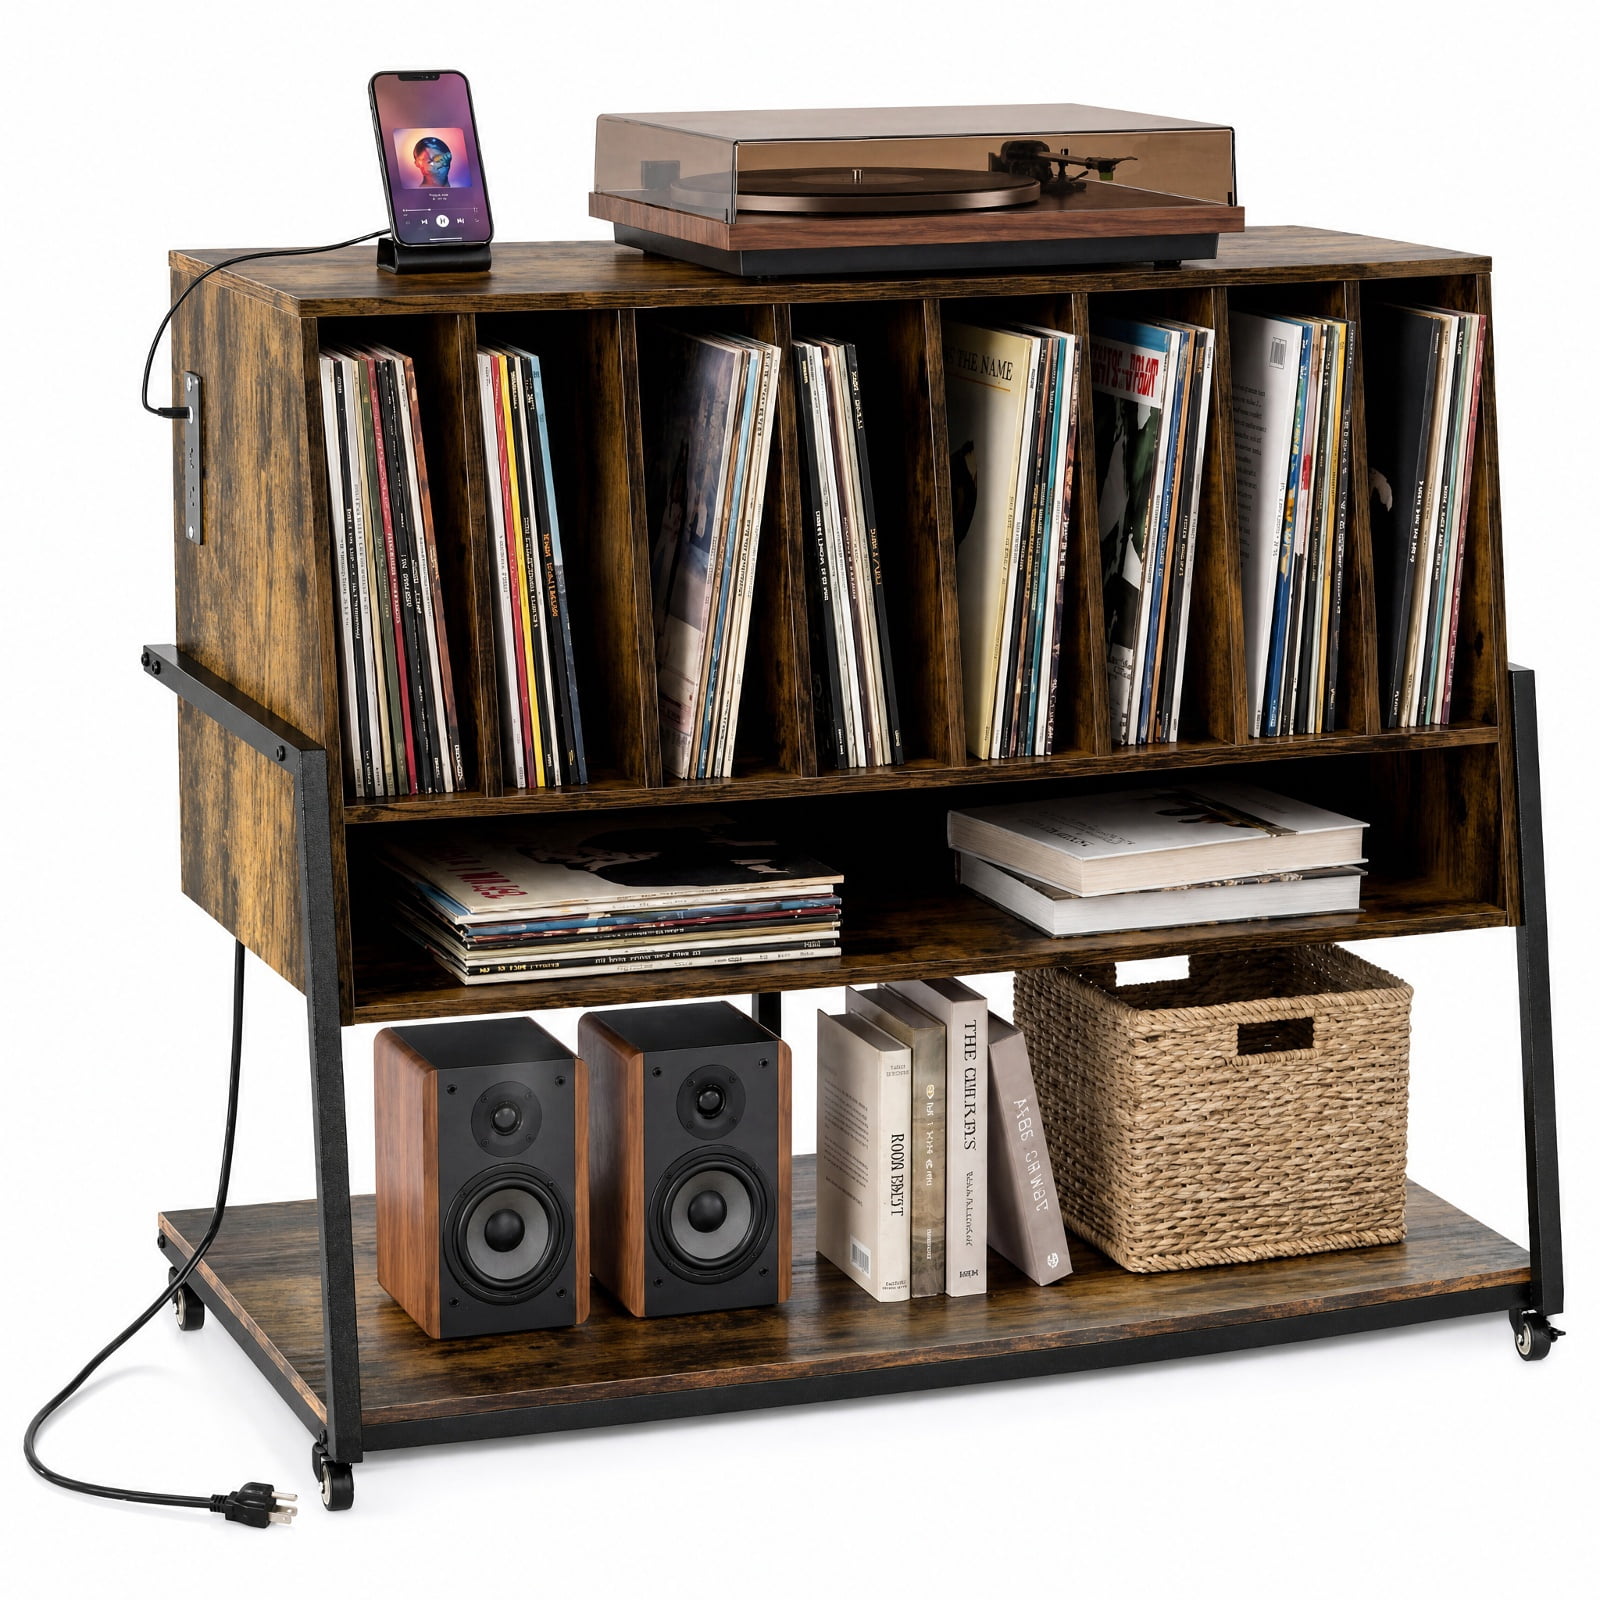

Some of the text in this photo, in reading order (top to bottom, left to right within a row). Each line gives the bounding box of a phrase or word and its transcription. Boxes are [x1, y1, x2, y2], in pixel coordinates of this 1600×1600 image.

[958, 349, 978, 372] THE
[980, 355, 1013, 381] NAME
[964, 1019, 978, 1061] THE
